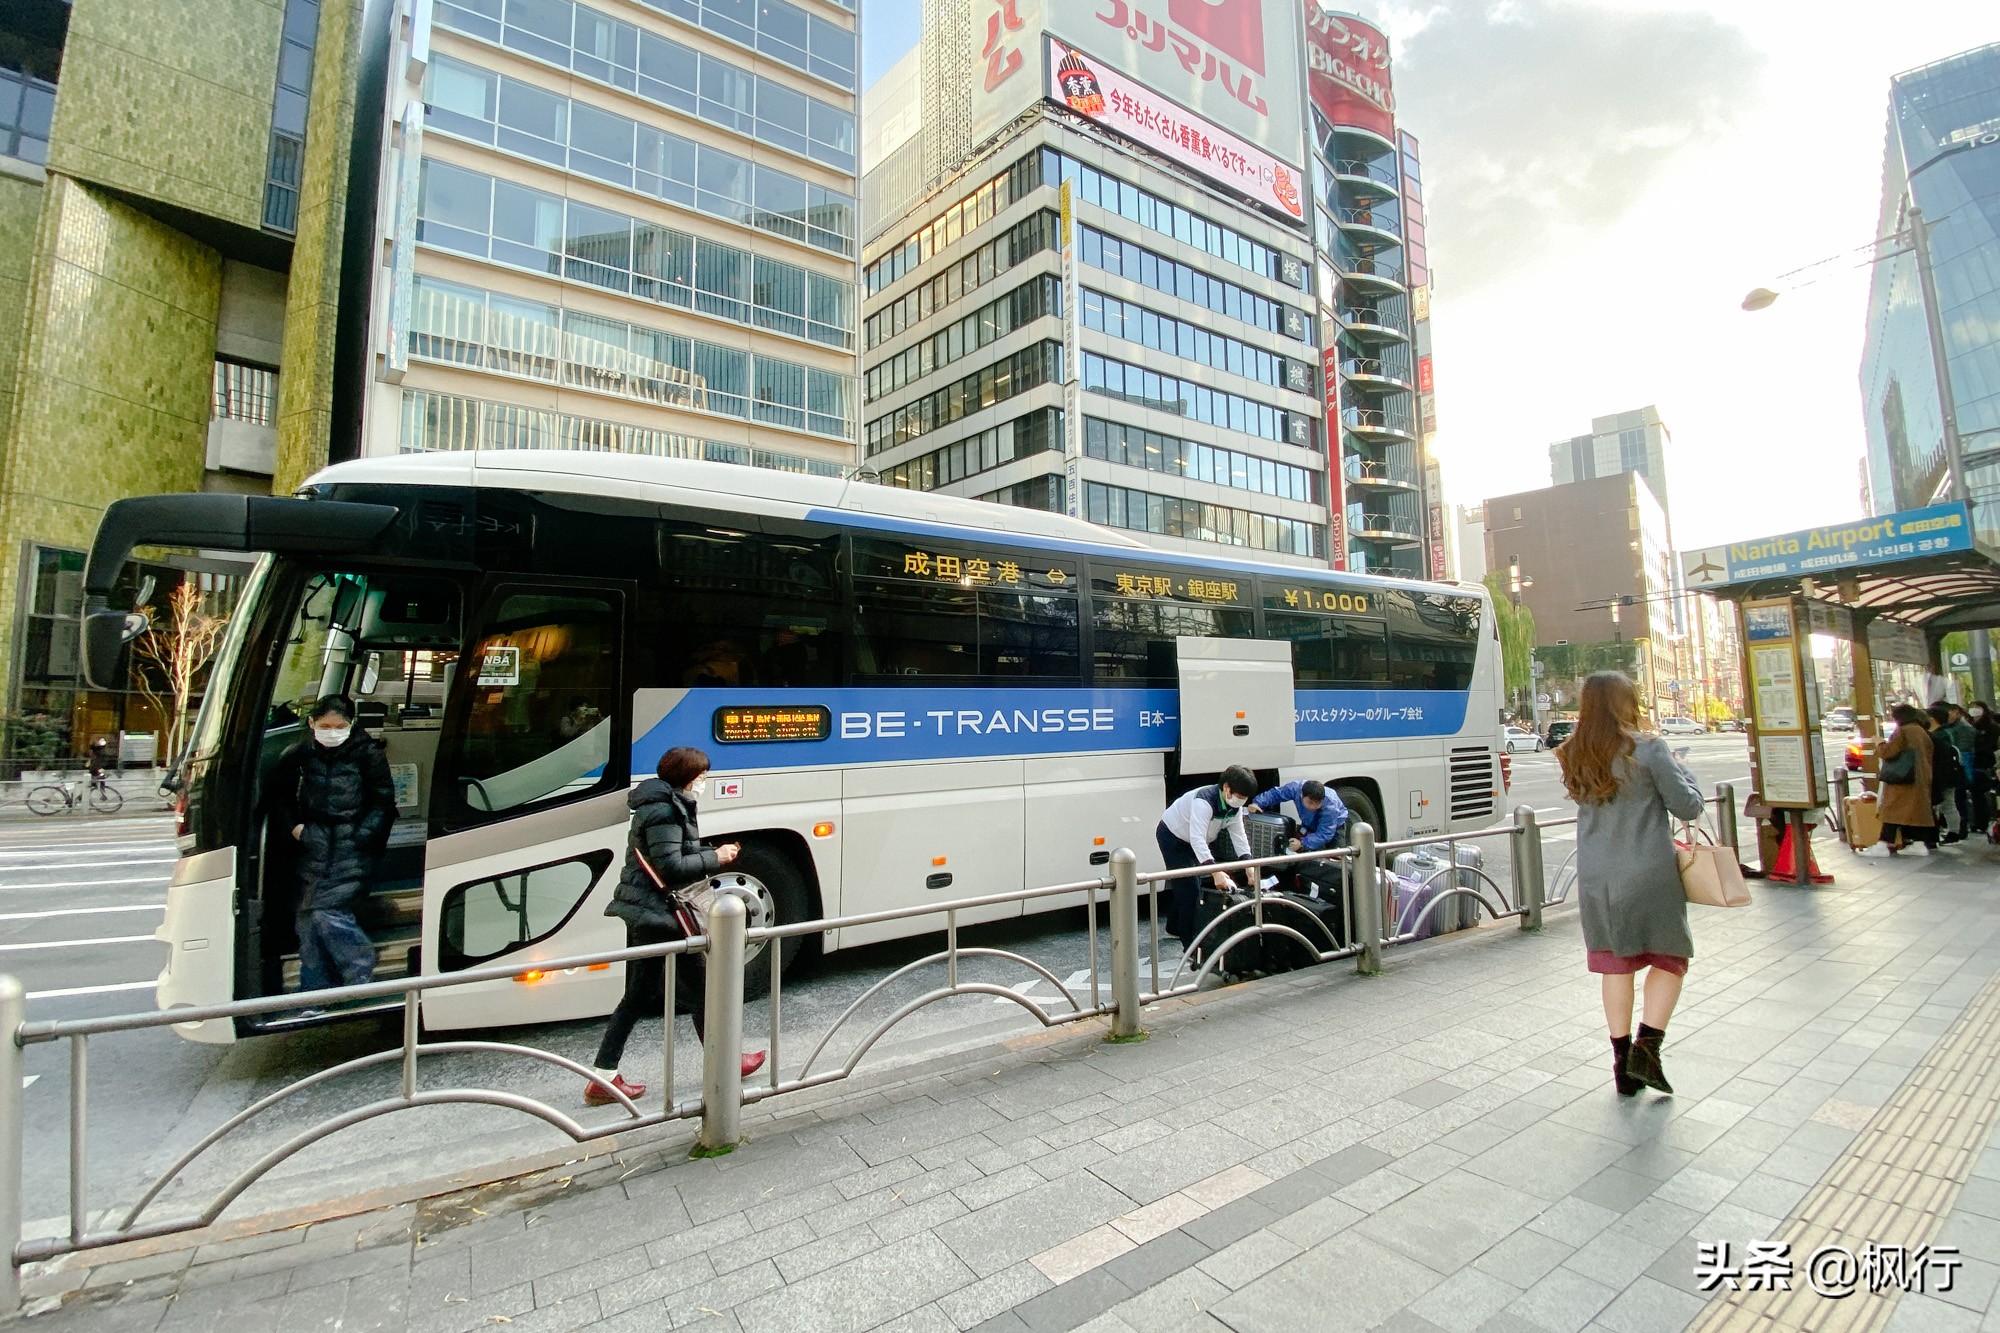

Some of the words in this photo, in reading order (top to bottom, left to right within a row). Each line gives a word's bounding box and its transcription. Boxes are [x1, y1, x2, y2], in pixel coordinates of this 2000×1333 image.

[1308, 5, 1393, 70] カラオケ
[1095, 0, 1269, 117] プリマハム
[1326, 356, 1336, 411] カラオケ
[1730, 537, 1799, 563] Narita
[1807, 518, 1895, 551] Airport
[1868, 542, 1915, 558] 나리타
[1918, 536, 1949, 550] 공항
[904, 551, 1020, 584] 成田空港
[1284, 588, 1367, 613] ¥1,000
[483, 656, 510, 666] NBA
